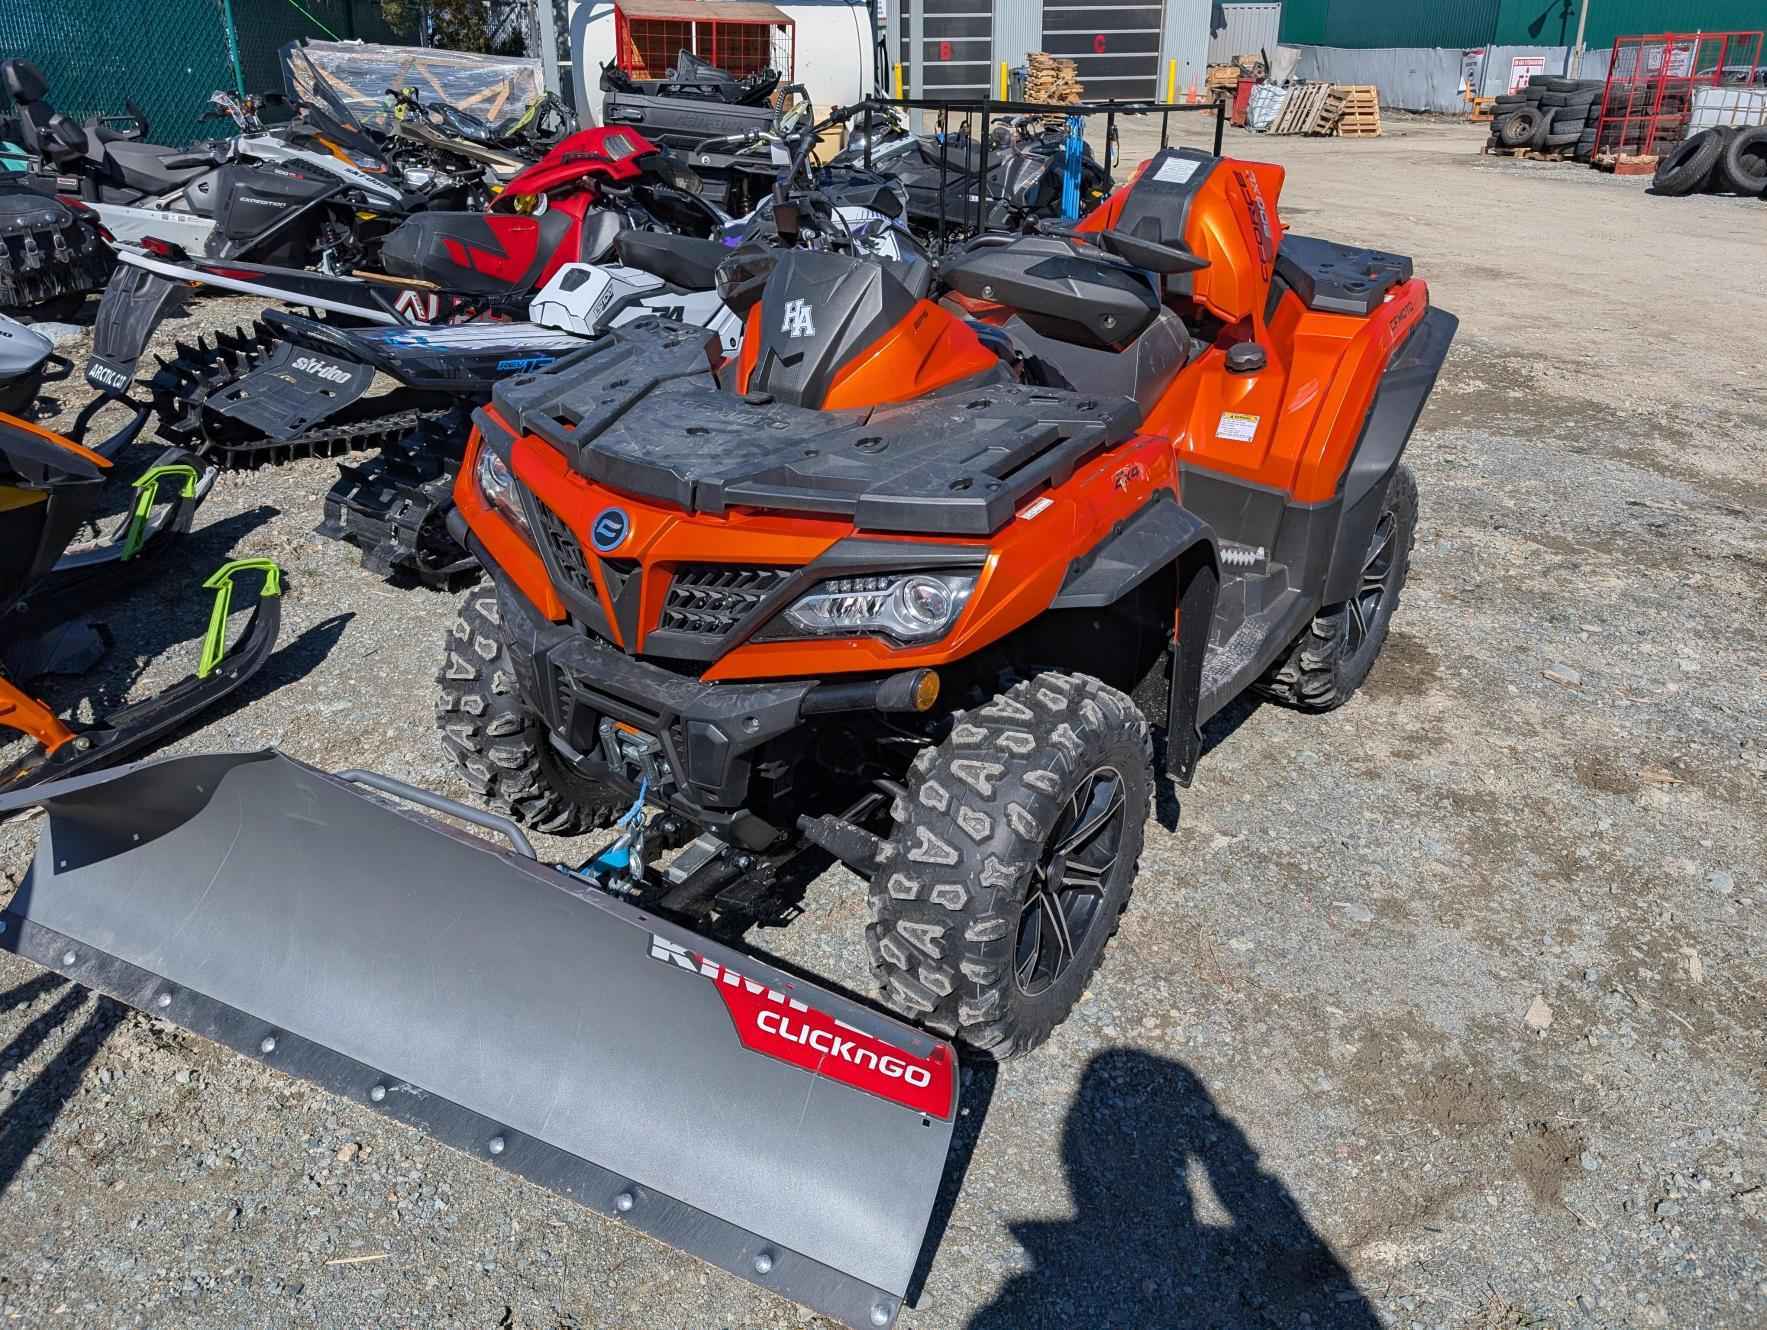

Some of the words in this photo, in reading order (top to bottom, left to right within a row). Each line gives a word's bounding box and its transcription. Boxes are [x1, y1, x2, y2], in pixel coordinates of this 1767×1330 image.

[939, 40, 954, 61] B
[1093, 34, 1105, 54] C
[239, 197, 287, 209] EXPEDITION
[779, 298, 817, 339] HA
[88, 362, 117, 385] ARCTIC
[112, 373, 128, 390] CAT
[291, 356, 353, 384] ski-doo
